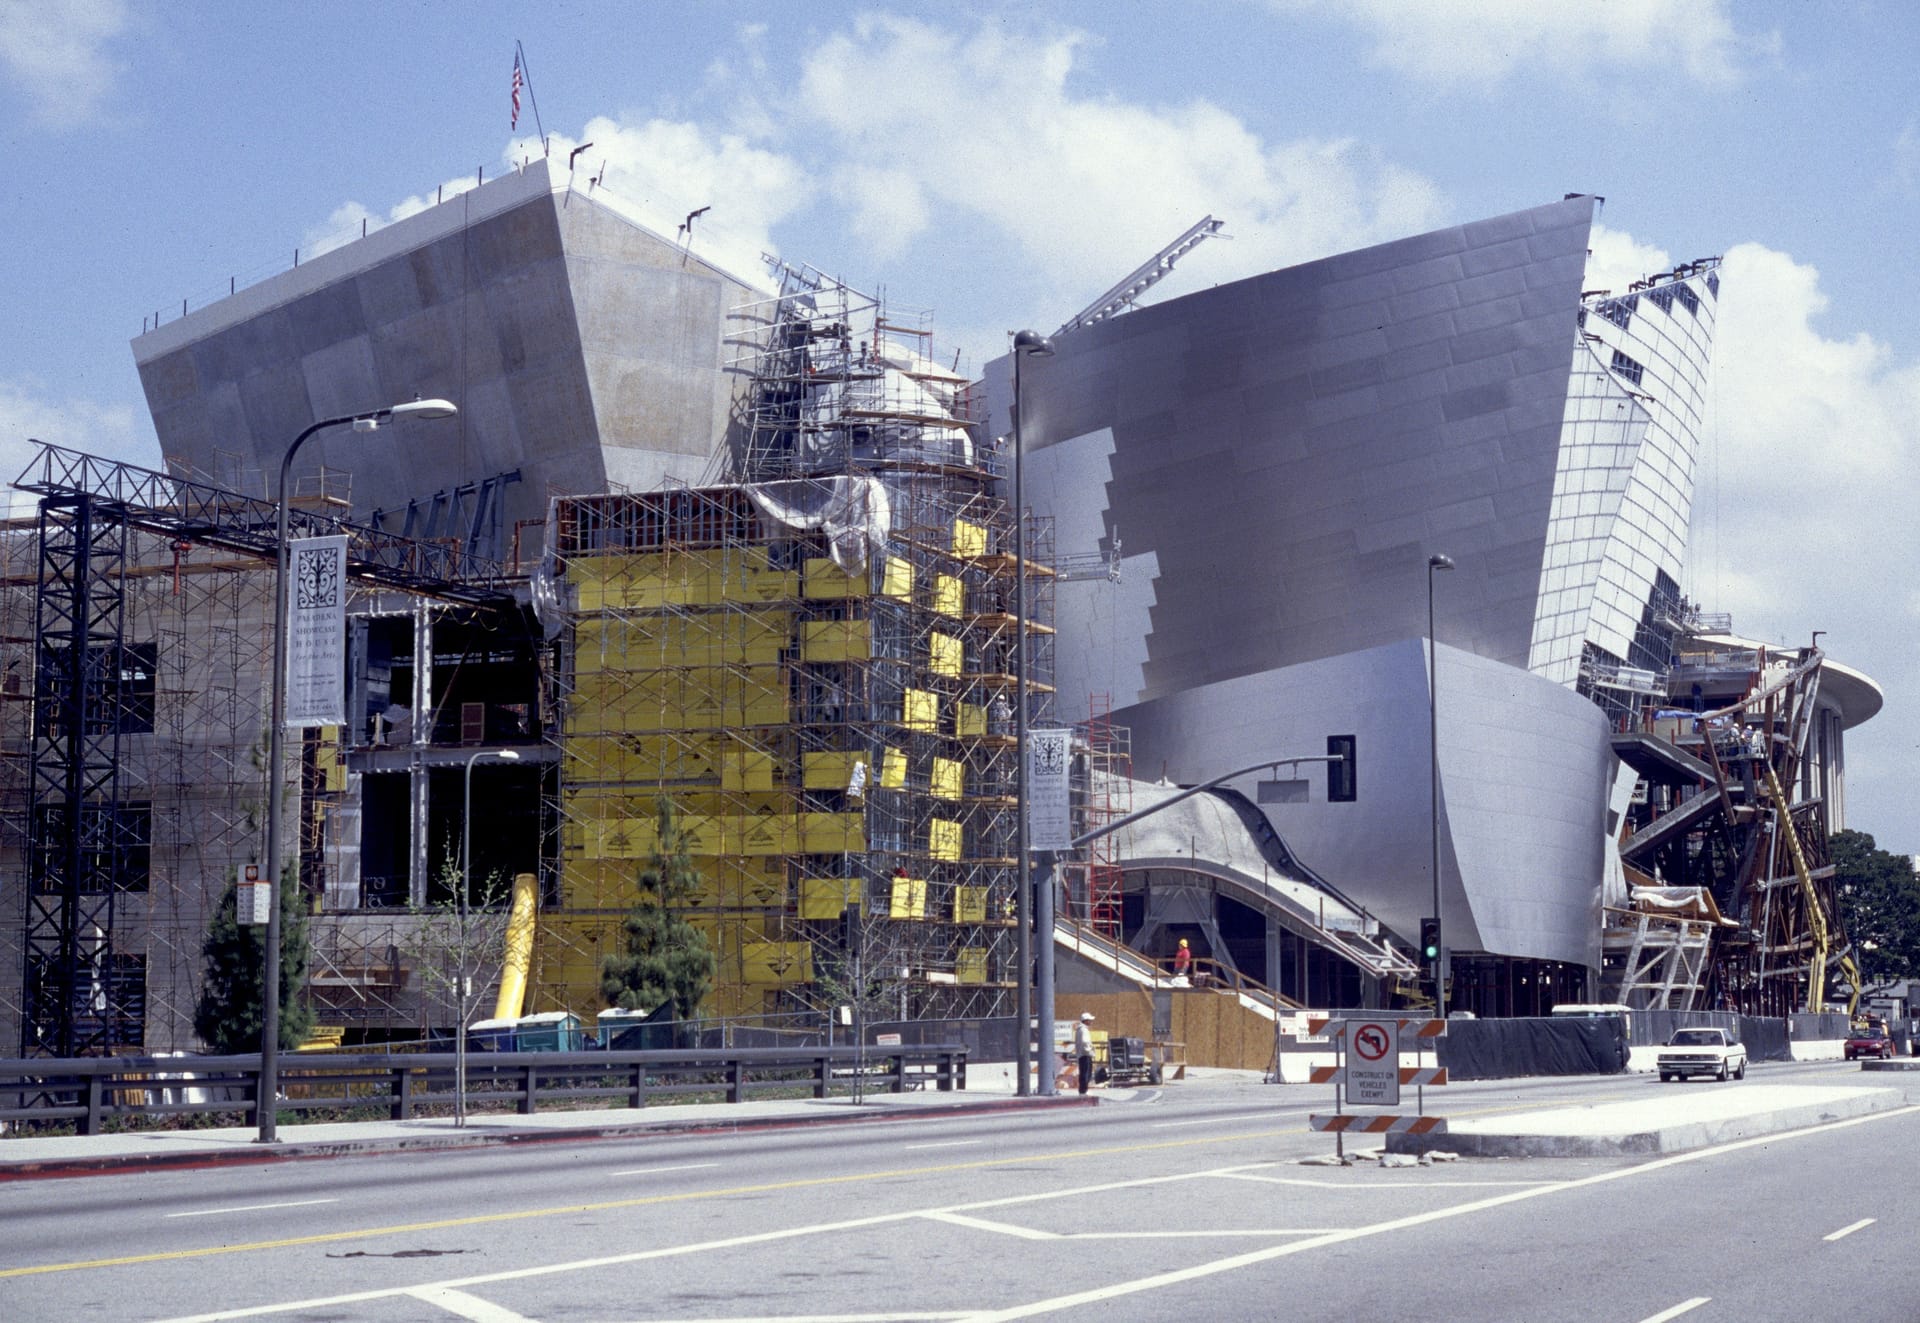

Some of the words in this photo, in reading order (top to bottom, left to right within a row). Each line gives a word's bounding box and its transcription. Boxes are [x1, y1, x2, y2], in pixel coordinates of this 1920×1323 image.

[296, 626, 336, 635] SHOWCASE
[295, 638, 336, 648] HOUSE
[1359, 1081, 1387, 1089] VEHICLES
[1361, 1090, 1384, 1098] EXEMPT
